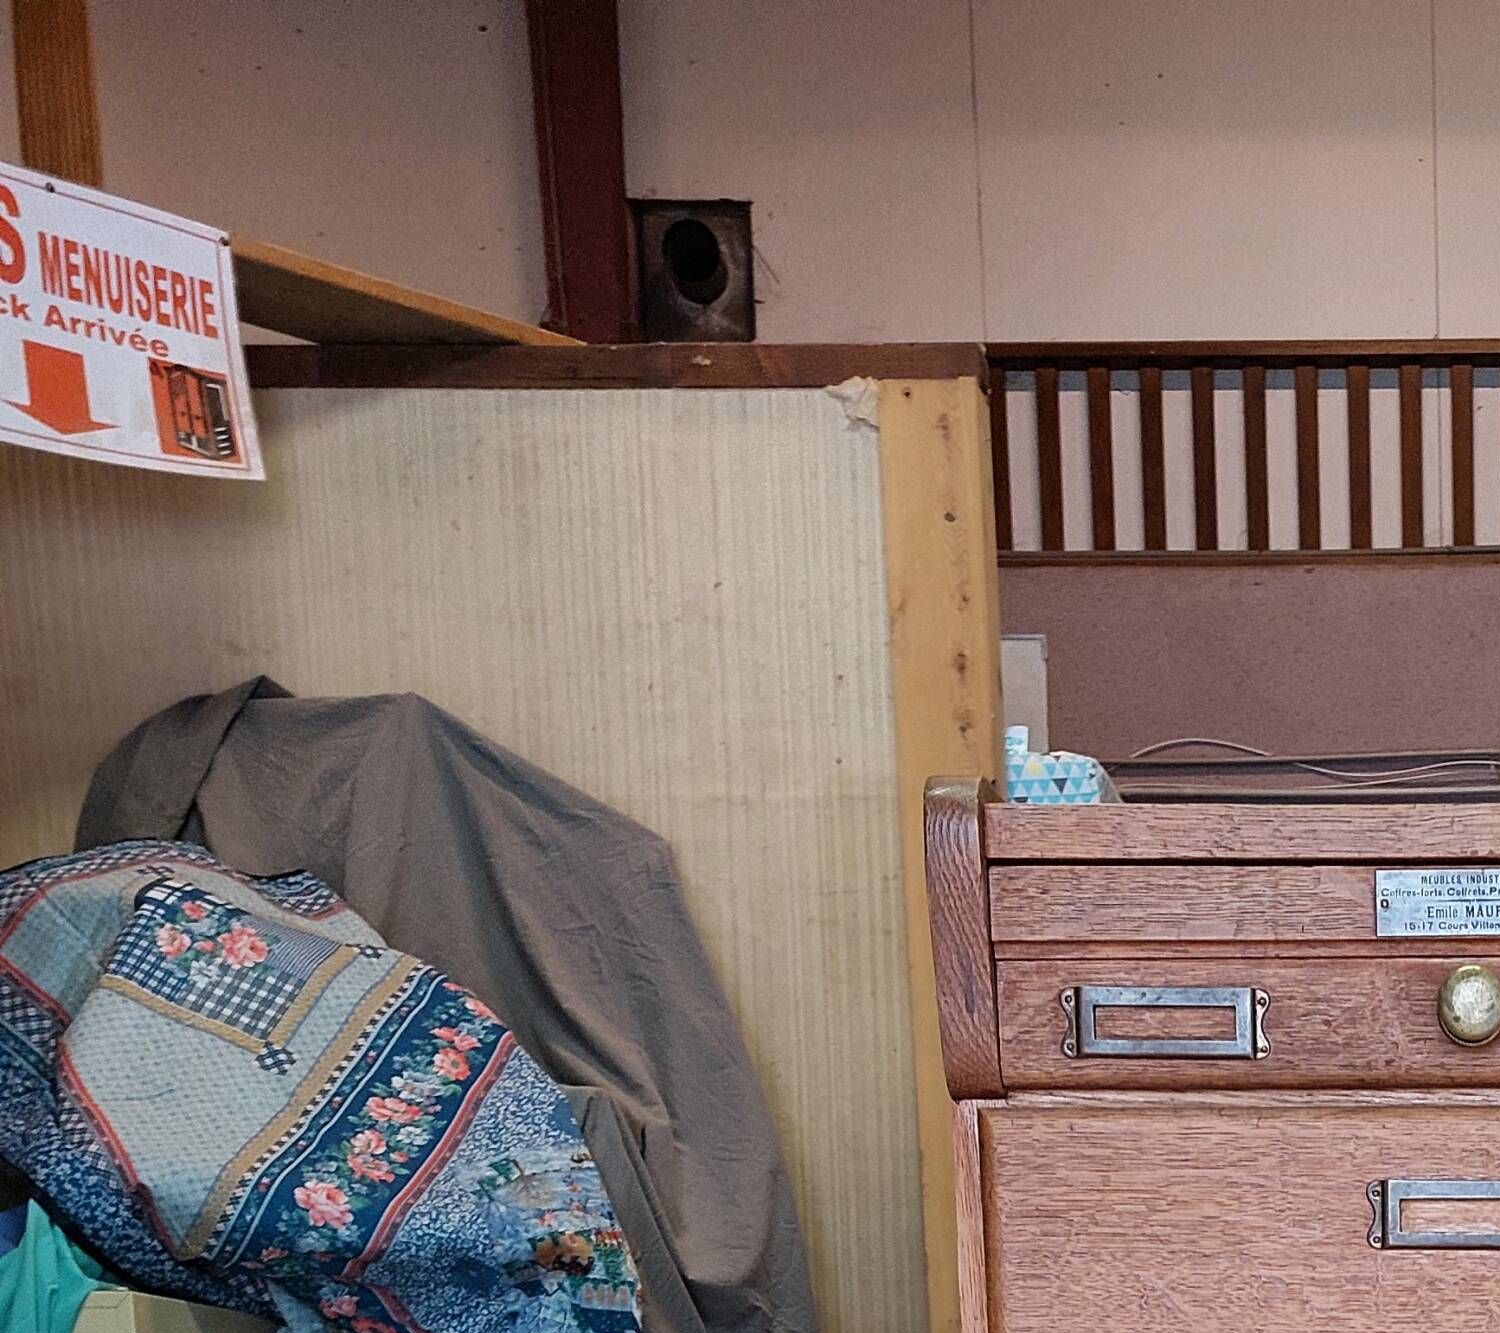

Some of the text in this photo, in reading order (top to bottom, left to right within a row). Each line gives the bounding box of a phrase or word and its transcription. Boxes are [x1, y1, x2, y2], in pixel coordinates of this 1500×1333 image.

[37, 231, 219, 339] MENUISERIE
[44, 304, 169, 358] Arrivée
[1421, 874, 1461, 885] MEUBLES
[1427, 905, 1458, 919] Emile
[1438, 921, 1469, 931] Cours
